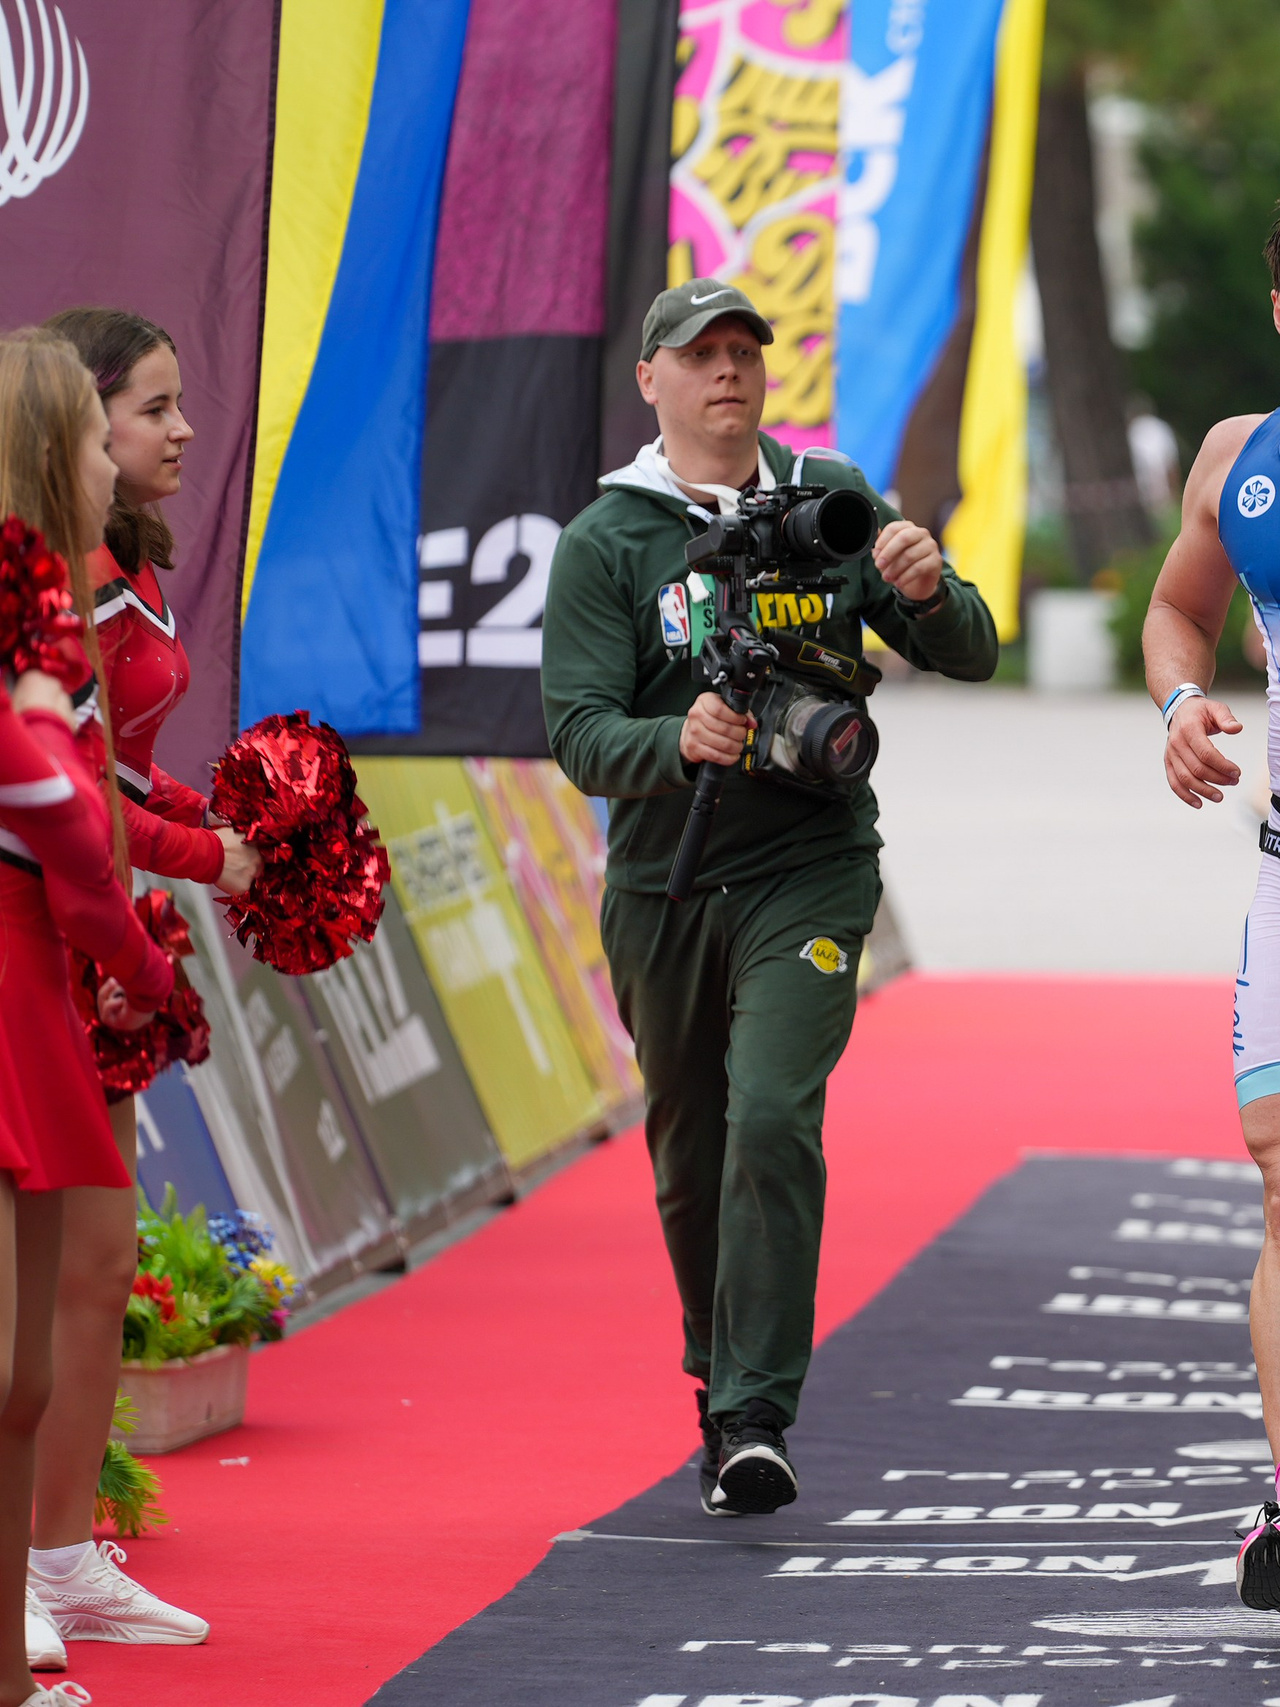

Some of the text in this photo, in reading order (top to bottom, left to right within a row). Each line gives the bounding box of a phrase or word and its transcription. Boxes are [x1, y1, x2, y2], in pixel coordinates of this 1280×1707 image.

[962, 1386, 1262, 1406] IRON
[840, 1502, 1183, 1522] IRON
[776, 1554, 1137, 1573] IRON
[634, 1693, 1046, 1707] IRON
